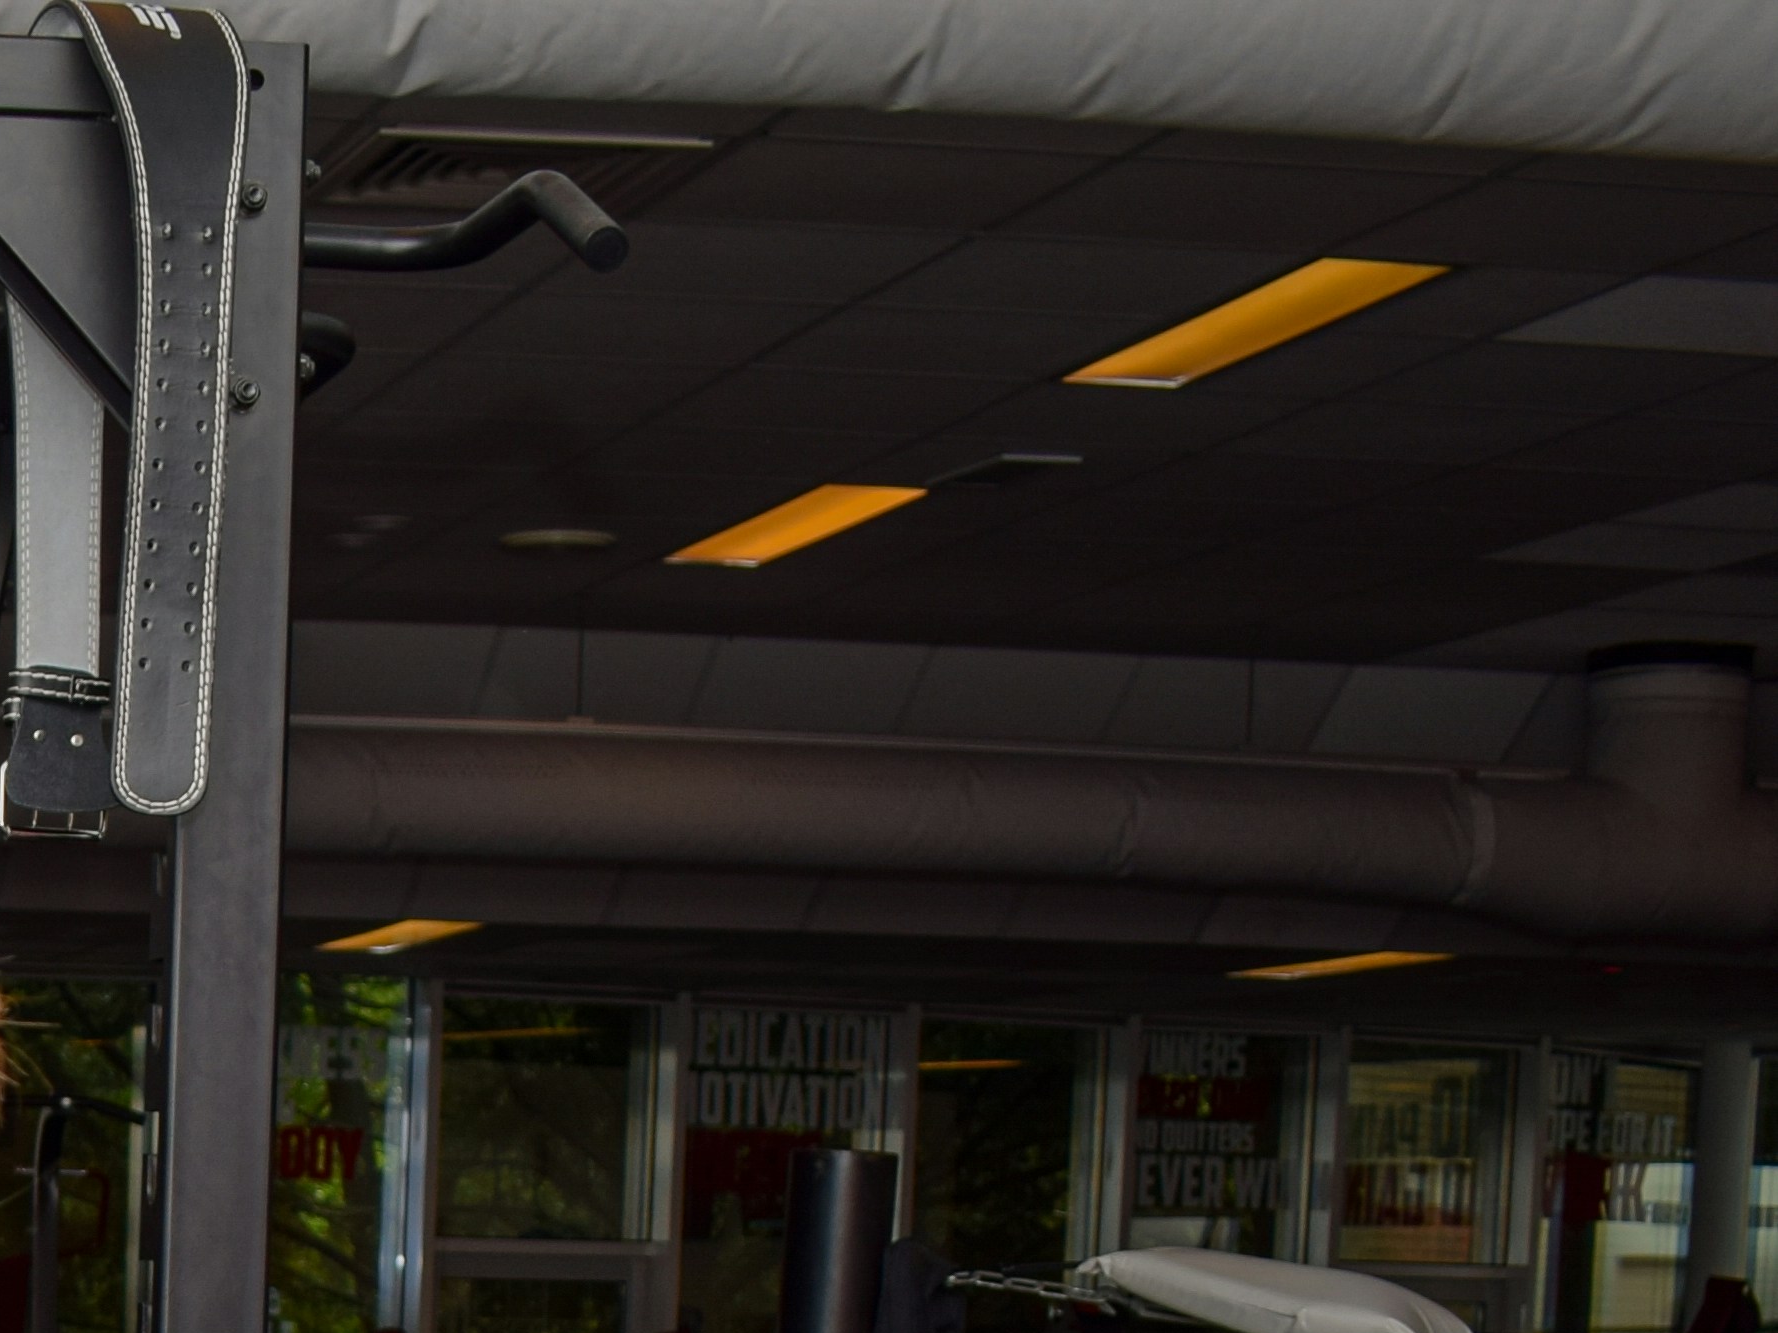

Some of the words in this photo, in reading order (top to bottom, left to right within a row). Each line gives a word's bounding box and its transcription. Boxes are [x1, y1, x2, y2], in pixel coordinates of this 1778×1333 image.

[696, 1008, 889, 1071] EDICATION
[693, 1070, 889, 1132] OTIVATION
[1546, 1109, 1592, 1151] OPE
[1137, 1155, 1226, 1208] EVER
